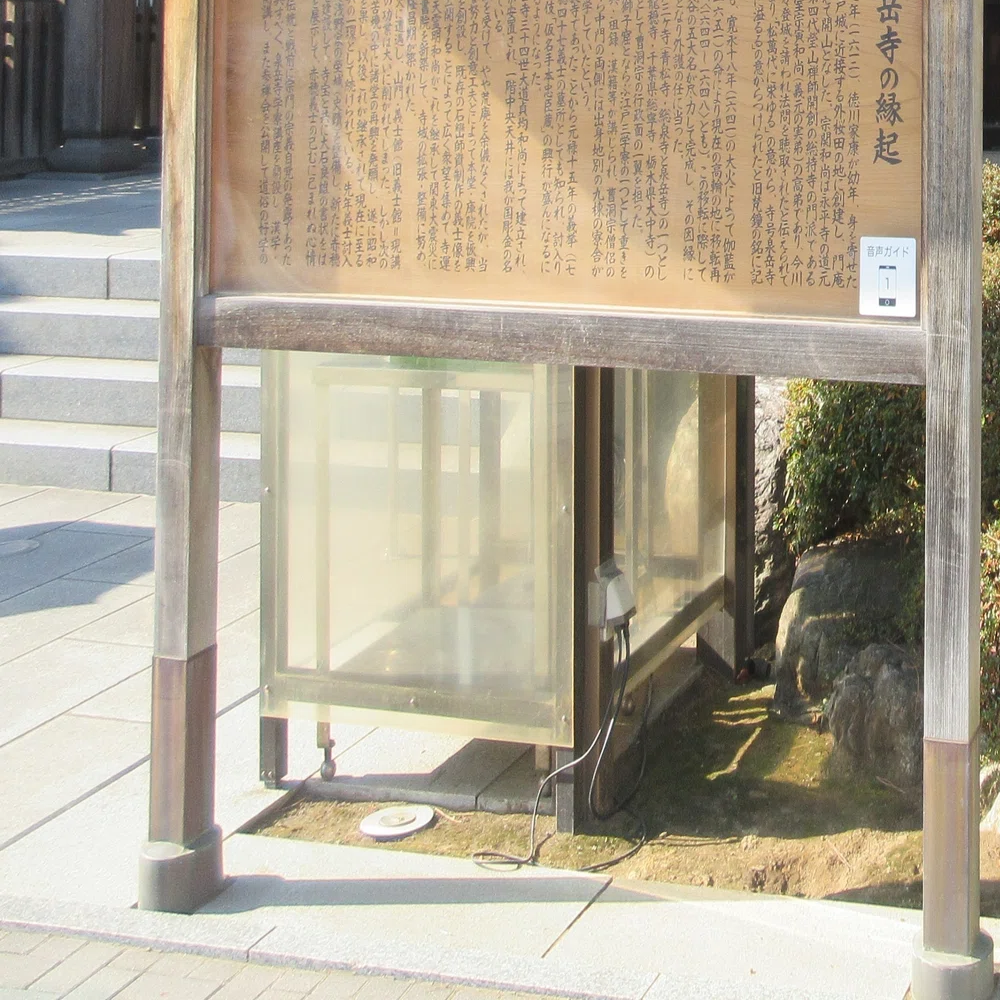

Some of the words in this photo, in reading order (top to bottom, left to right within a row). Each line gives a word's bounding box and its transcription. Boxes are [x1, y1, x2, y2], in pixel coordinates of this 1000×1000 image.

[867, 245, 909, 258] 音声ガイド
[885, 277, 889, 290] 1
